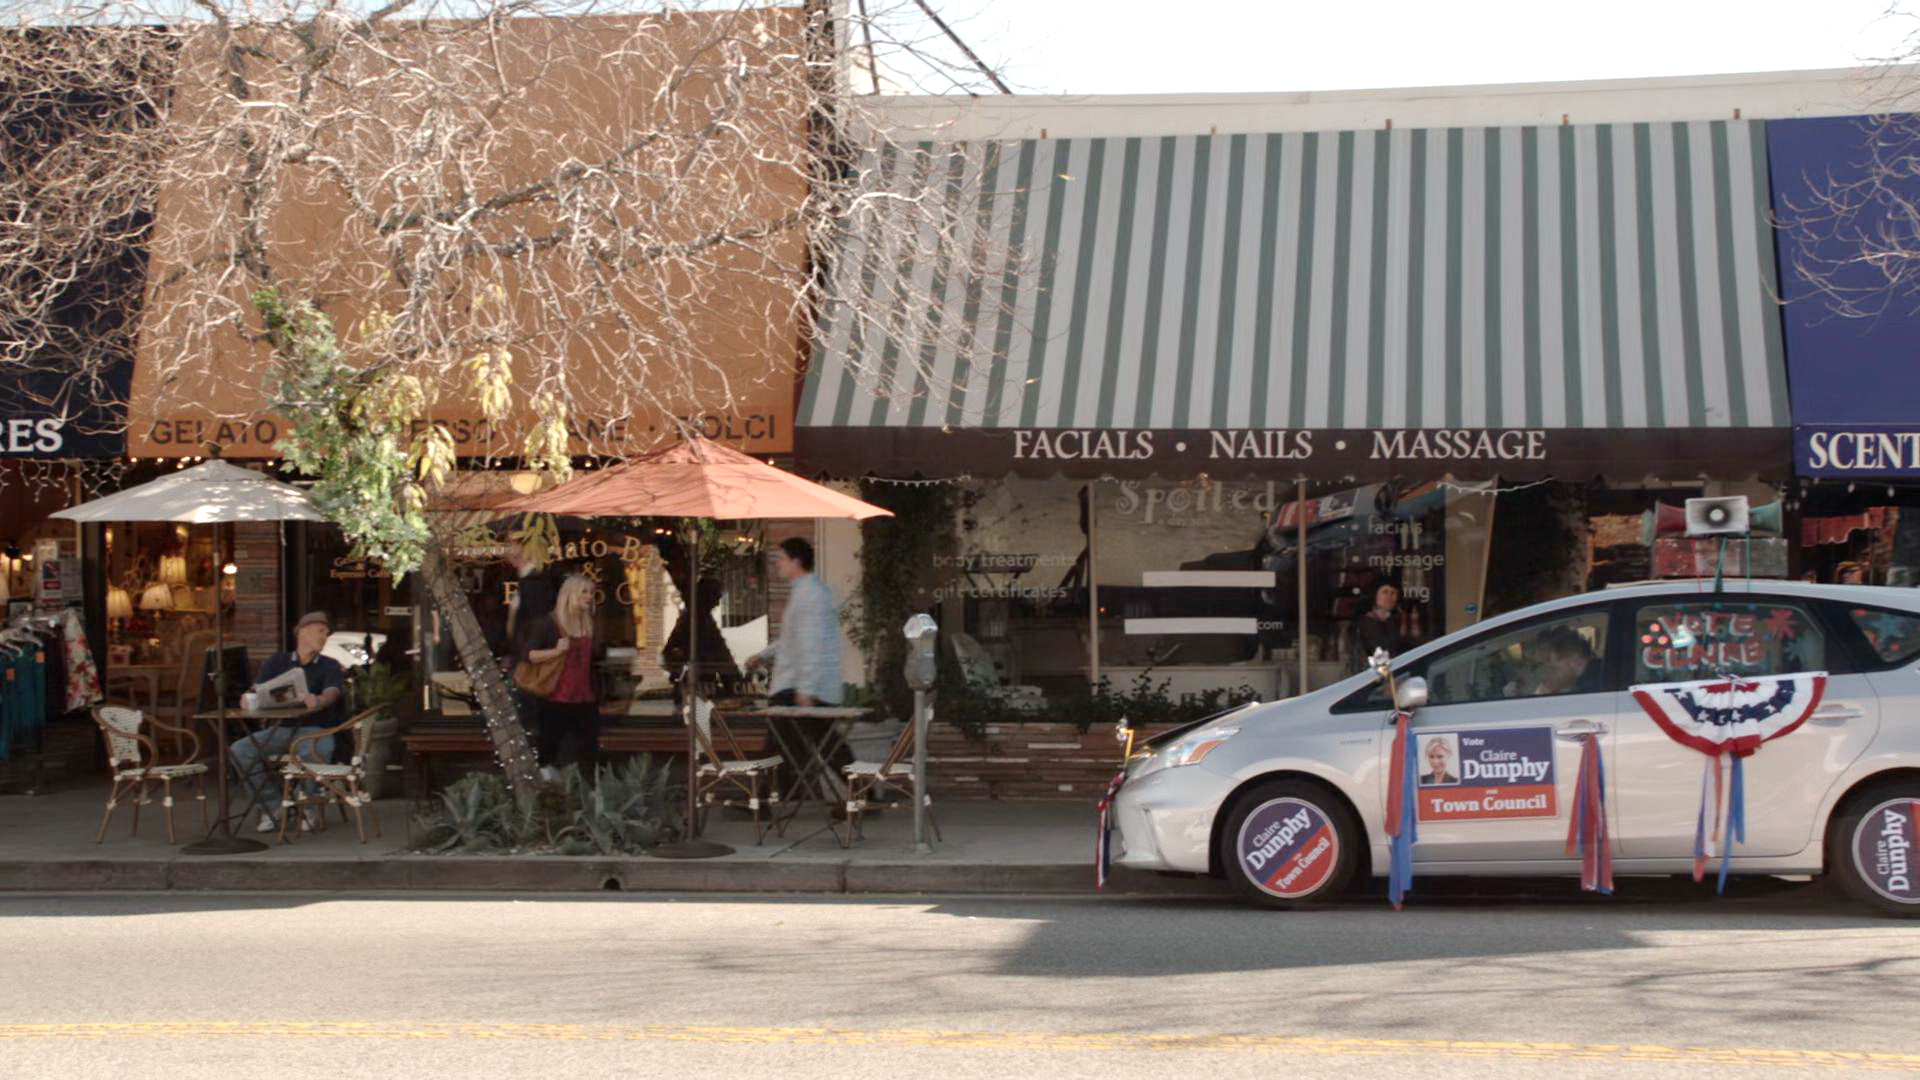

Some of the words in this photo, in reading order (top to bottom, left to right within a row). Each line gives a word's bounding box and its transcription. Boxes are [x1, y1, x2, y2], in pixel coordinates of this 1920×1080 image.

[152, 420, 277, 445] GELATO
[563, 417, 627, 442] ANE
[676, 414, 776, 441] DOLCI
[1013, 430, 1154, 460] FACIALS
[1209, 430, 1313, 460] NAILS
[1369, 430, 1547, 460] MASSAGE
[1115, 480, 1278, 524] Spoiled
[1368, 553, 1445, 571] massage
[1462, 737, 1485, 747] Vote
[1480, 749, 1518, 762] Claire
[1463, 756, 1550, 783] Dunphy
[1431, 798, 1479, 813] Town
[1483, 794, 1547, 811] Council
[1246, 807, 1313, 871] Dunphy
[1252, 820, 1281, 848] Claire
[1275, 866, 1303, 890] Town
[1298, 836, 1331, 869] Council
[1876, 840, 1890, 875] Claire
[1881, 809, 1911, 891] Dunphy
